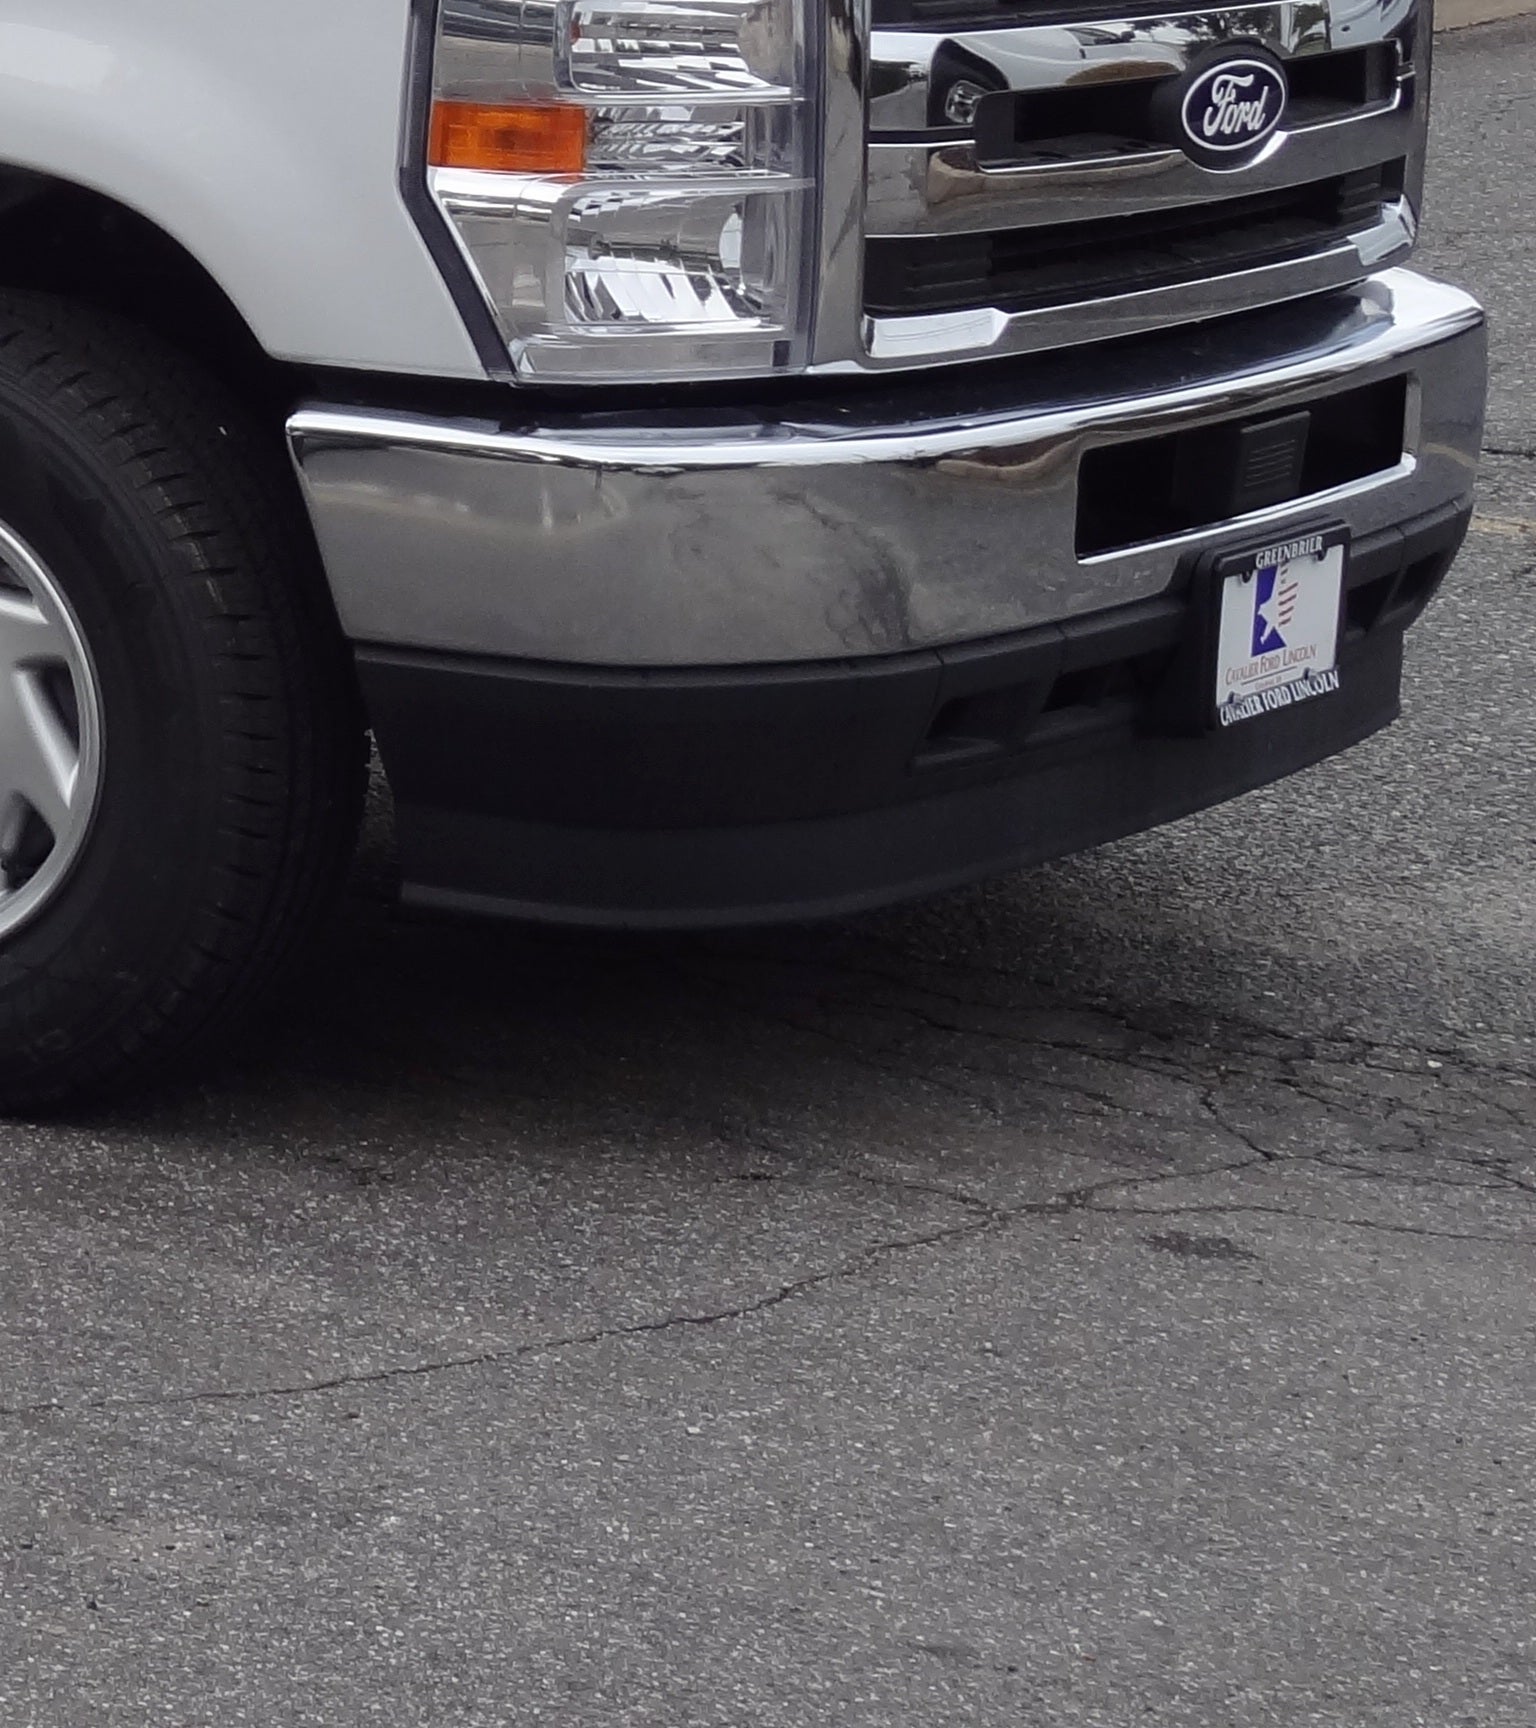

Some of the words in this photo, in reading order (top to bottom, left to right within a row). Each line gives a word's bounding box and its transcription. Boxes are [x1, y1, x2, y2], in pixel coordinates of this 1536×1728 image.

[1203, 74, 1269, 137] Ford
[1255, 536, 1323, 569] GREENBRIER
[1220, 694, 1264, 727] CAVALIER
[1261, 685, 1292, 711] FORD
[1289, 670, 1340, 702] LINCOLN
